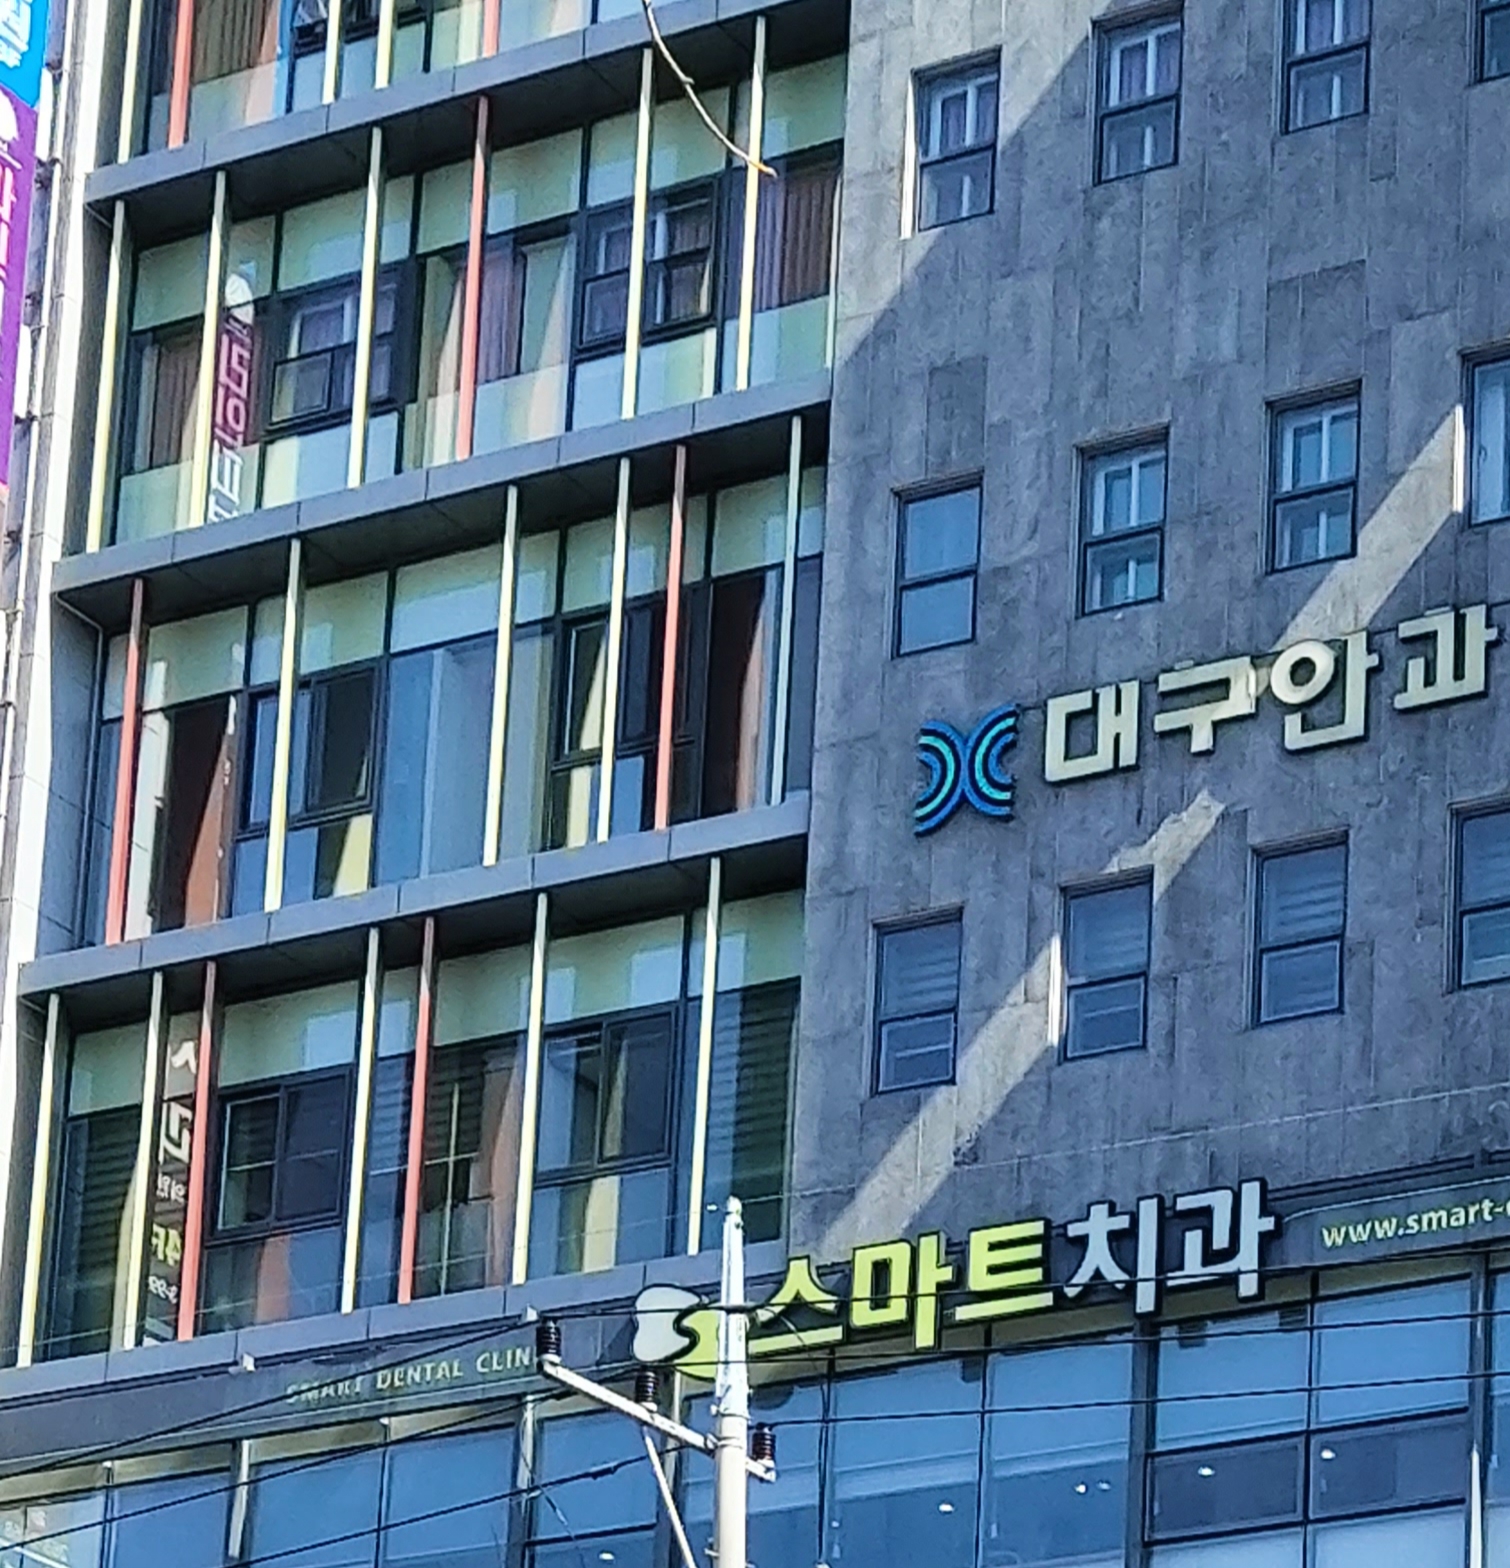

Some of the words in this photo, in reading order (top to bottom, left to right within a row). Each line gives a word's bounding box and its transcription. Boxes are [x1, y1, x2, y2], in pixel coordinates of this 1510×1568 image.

[1043, 603, 1499, 786] 대구안과
[743, 1178, 1278, 1352] 스마트치과
[376, 1362, 464, 1390] DENTAL
